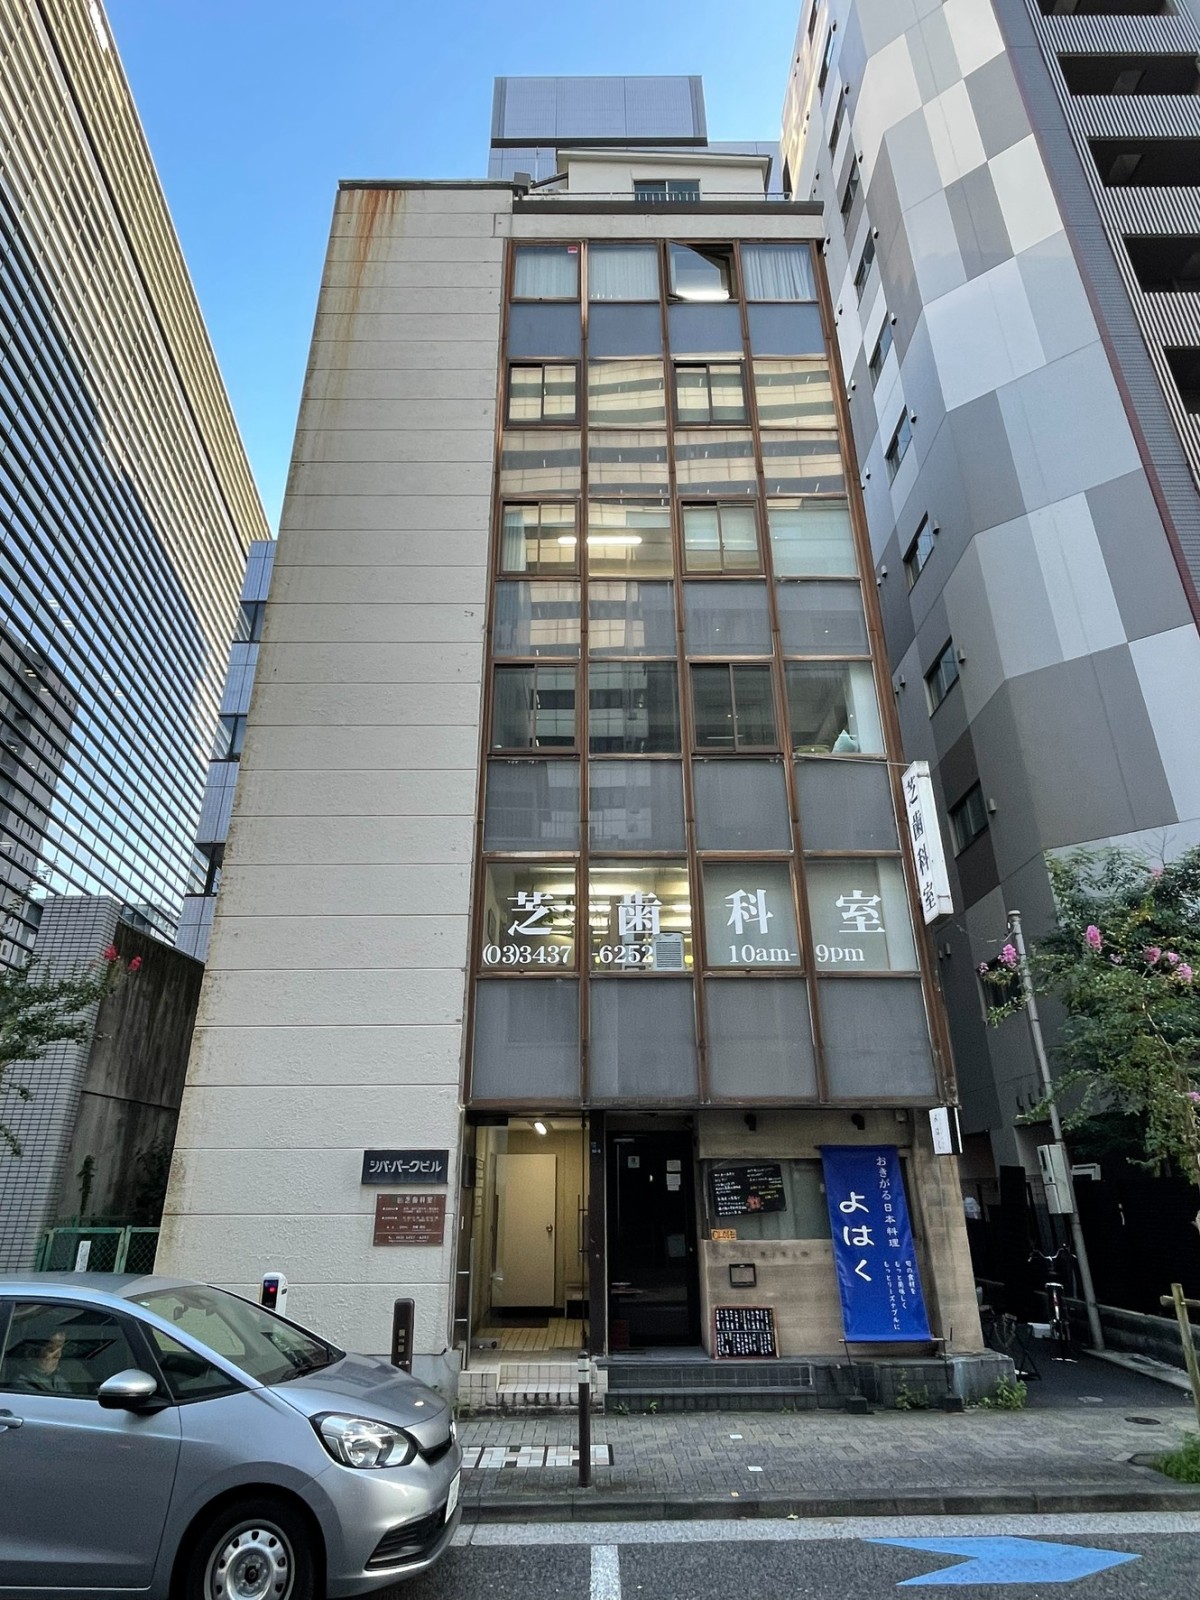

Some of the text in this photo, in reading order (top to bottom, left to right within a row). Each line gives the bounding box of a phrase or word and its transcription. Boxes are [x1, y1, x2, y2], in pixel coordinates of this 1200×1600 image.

[904, 774, 937, 913] 芝歯科室
[507, 888, 886, 936] 芝歯科室
[482, 943, 572, 965] (03)3437
[728, 944, 865, 963] 10am- 9pm
[876, 1155, 901, 1248] おきがる日本料理
[839, 1191, 875, 1282] よはく
